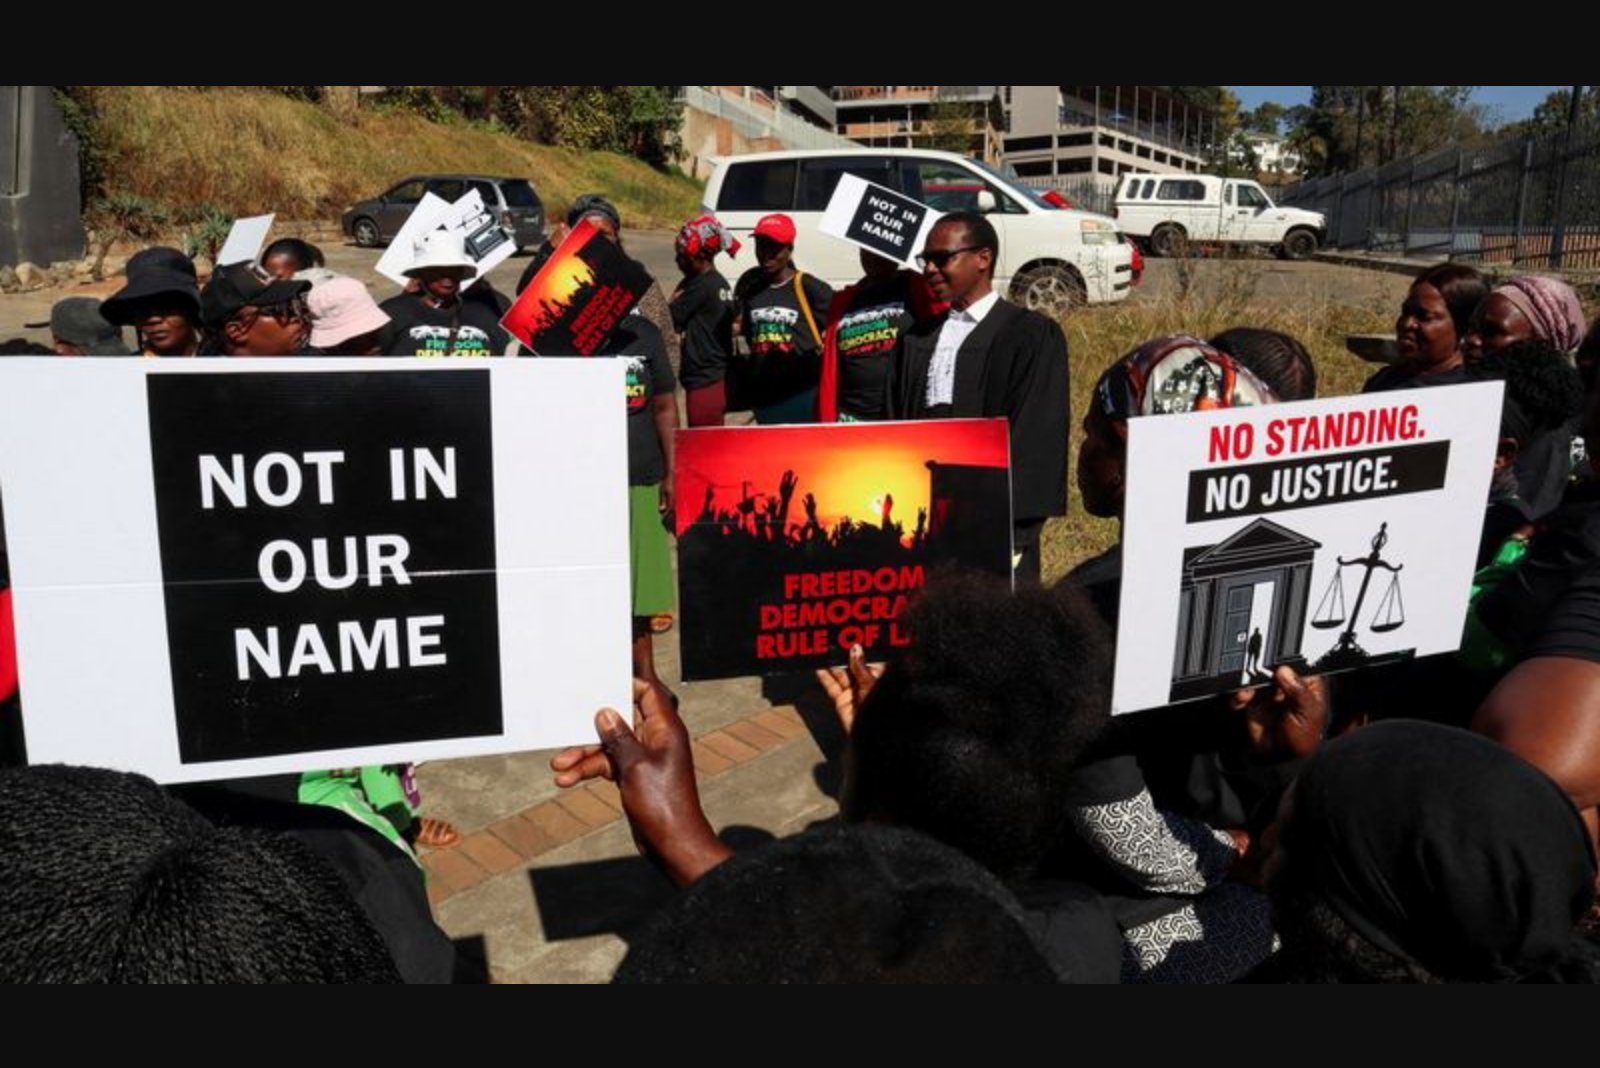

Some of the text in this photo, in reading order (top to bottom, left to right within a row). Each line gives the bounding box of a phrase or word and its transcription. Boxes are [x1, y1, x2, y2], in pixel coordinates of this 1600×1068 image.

[868, 195, 918, 223] NOT IN
[873, 211, 903, 231] OUR
[861, 221, 904, 247] NAME
[1208, 404, 1425, 463] NO STANDING.
[198, 446, 457, 509] NOT IN
[1205, 455, 1398, 513] NO JUSTICE.
[257, 533, 412, 593] OUR
[784, 564, 926, 599] FREEDOM
[234, 614, 447, 681] NAME
[756, 629, 829, 659] RULE
[837, 623, 880, 650] OF
